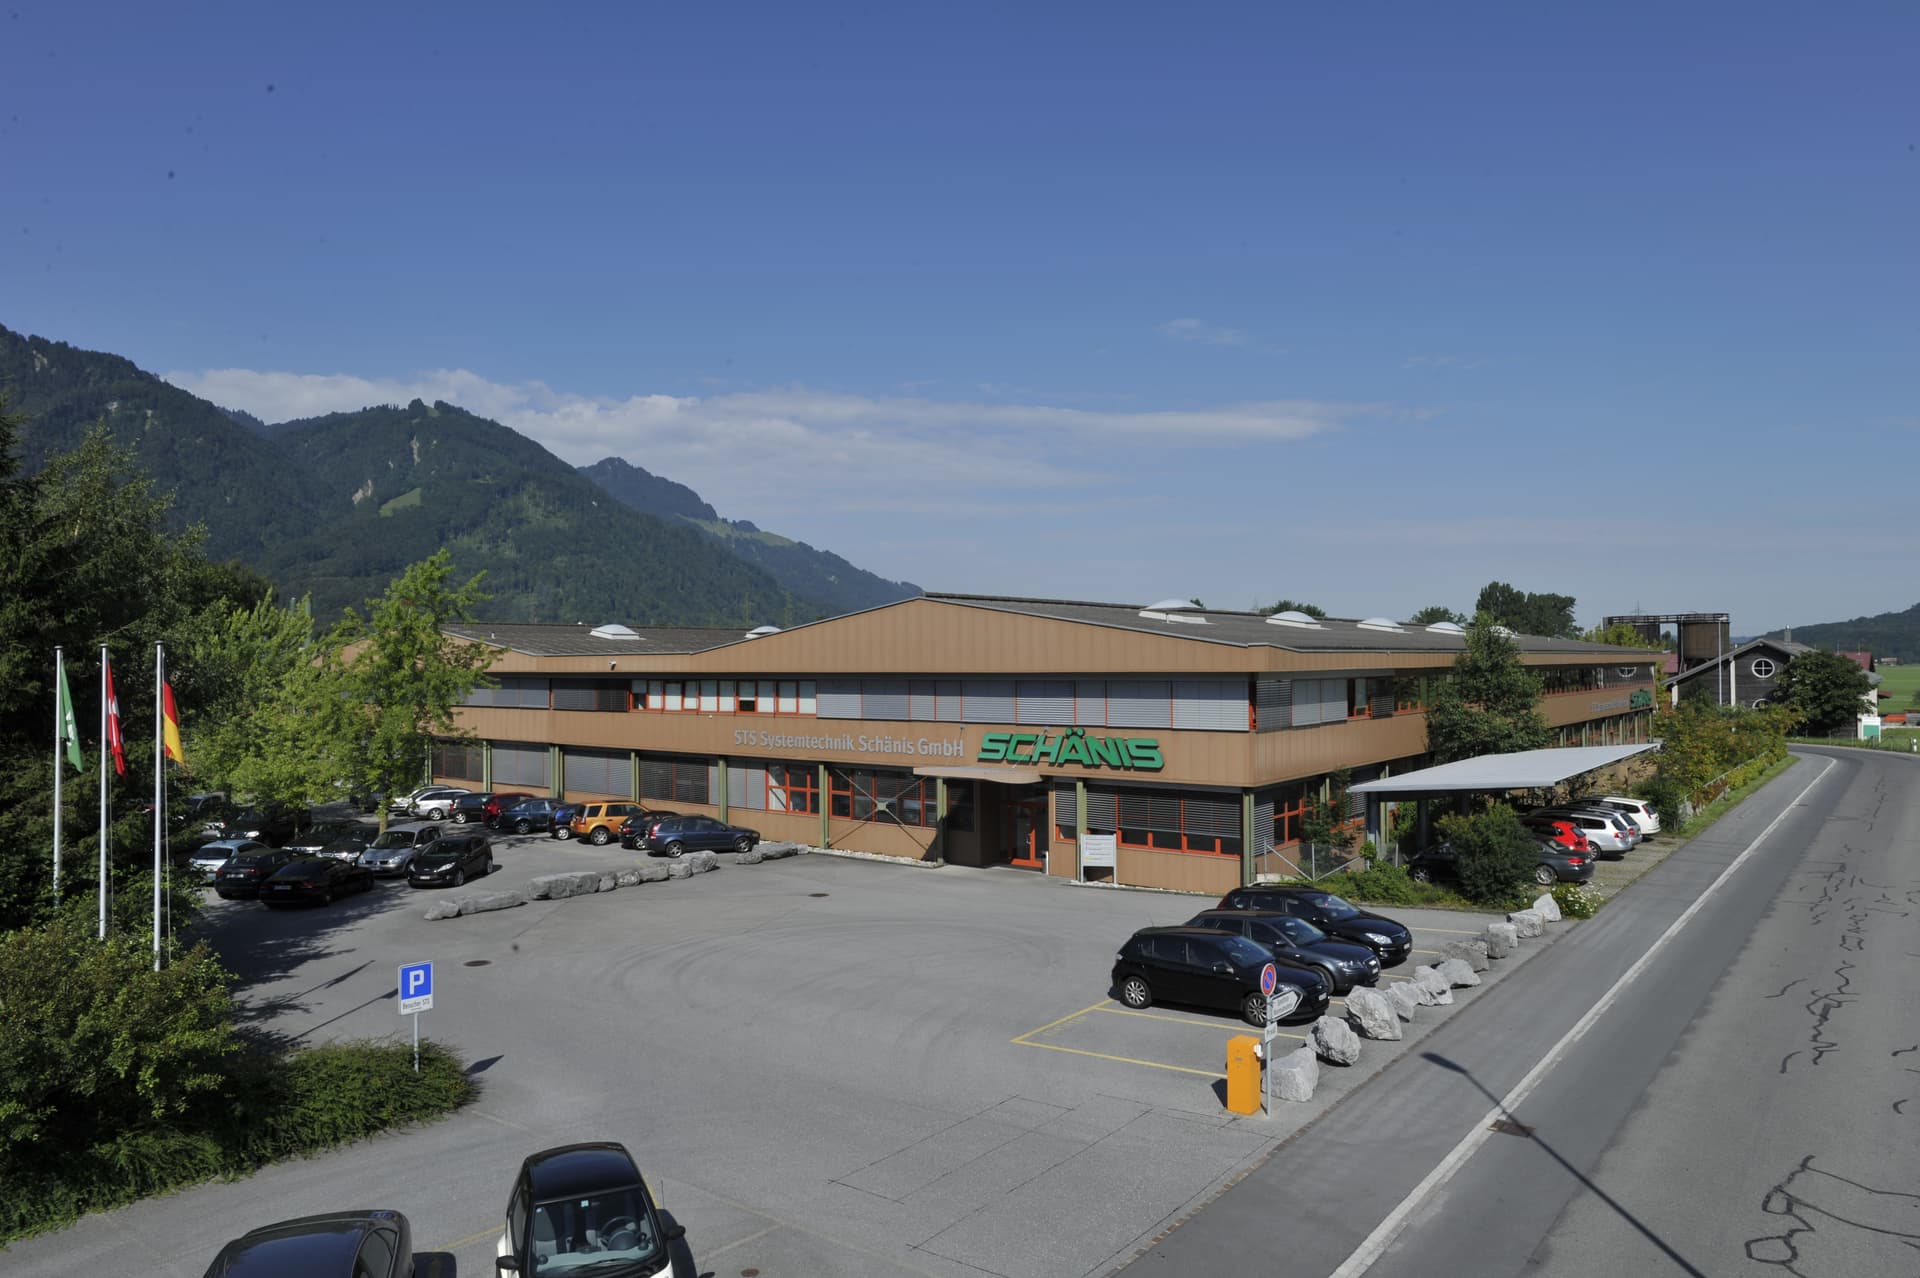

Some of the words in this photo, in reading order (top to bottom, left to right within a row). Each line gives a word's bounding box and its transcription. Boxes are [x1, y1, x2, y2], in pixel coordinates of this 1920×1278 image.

[735, 729, 757, 746] STS
[760, 730, 854, 751] Systemtechnik
[858, 735, 915, 754] Schänis
[918, 737, 965, 757] GmbH
[977, 727, 1165, 770] SCHÄNIS
[409, 969, 425, 995] P
